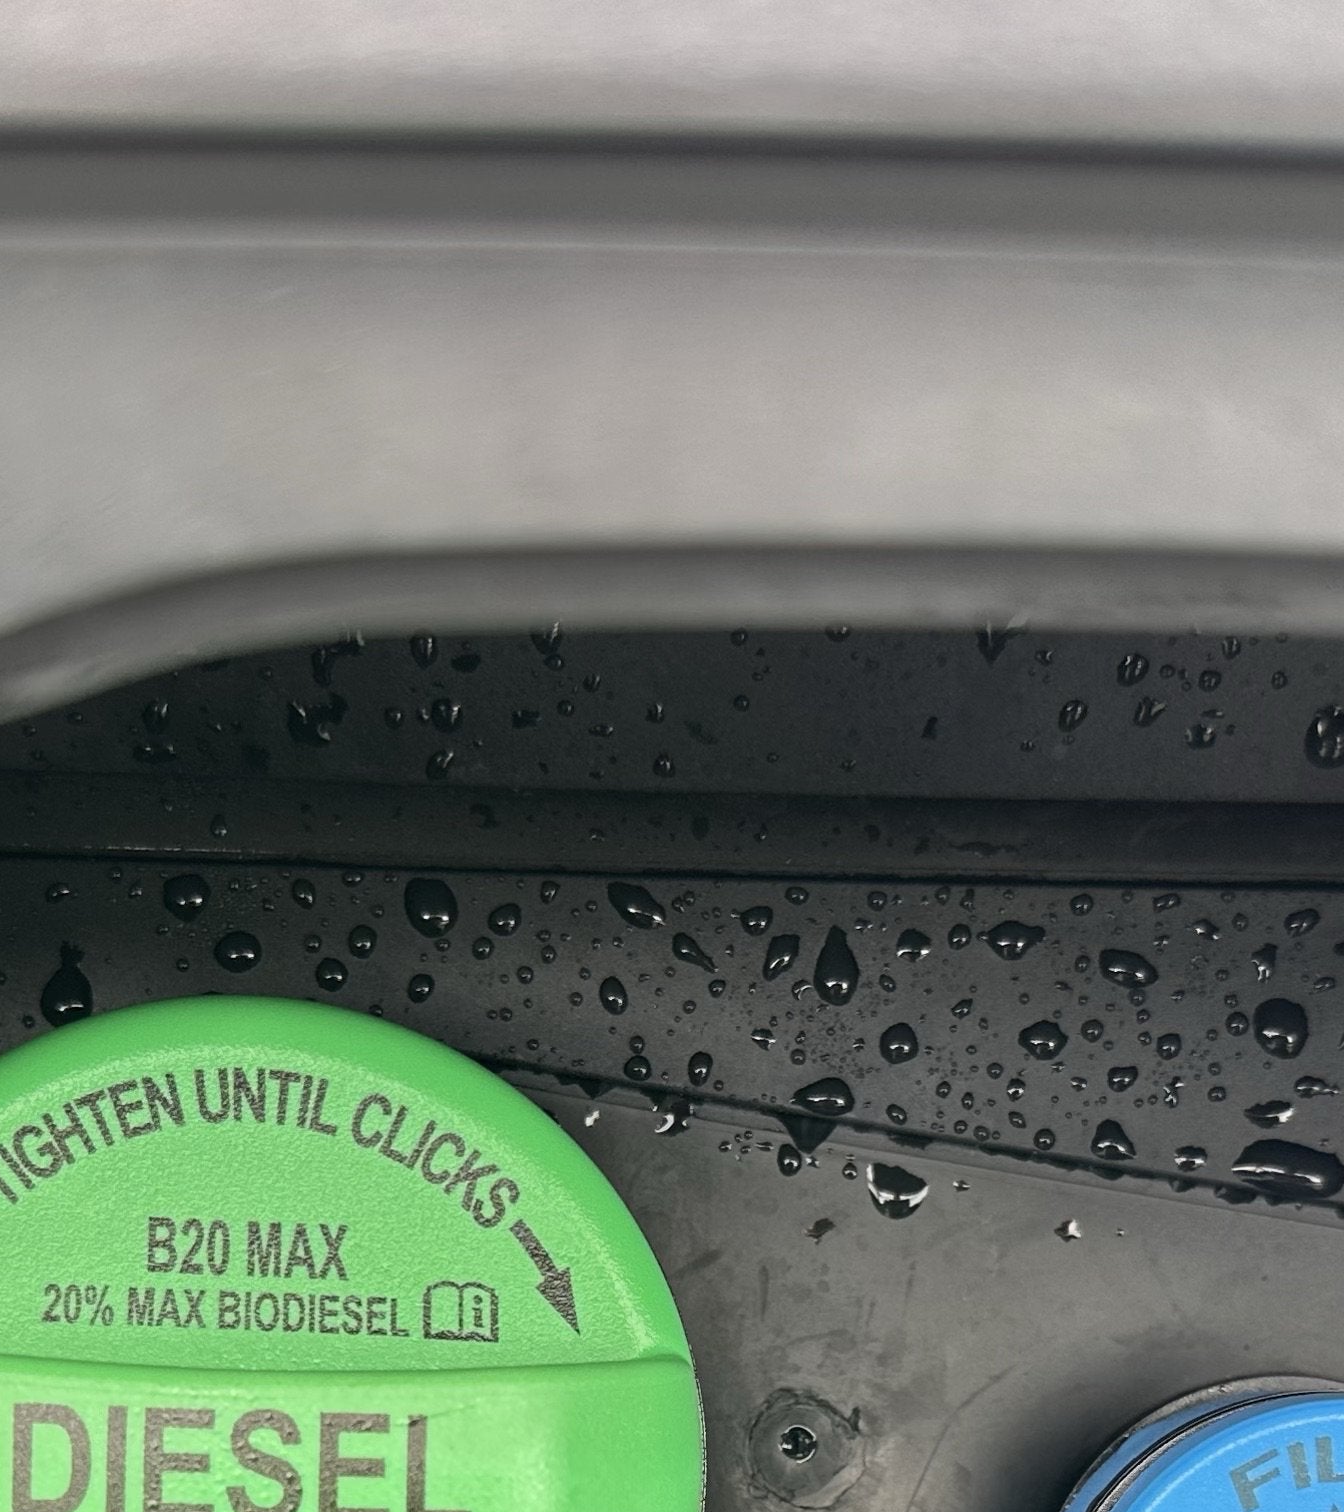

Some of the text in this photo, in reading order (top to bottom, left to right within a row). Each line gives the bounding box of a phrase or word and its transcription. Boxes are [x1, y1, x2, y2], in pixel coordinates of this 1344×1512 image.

[194, 1067, 338, 1134] UNTIL
[351, 1093, 520, 1229] CLICKS
[147, 1217, 349, 1281] B20 MAX
[42, 1285, 409, 1339] 20% MAX BIODIESEL
